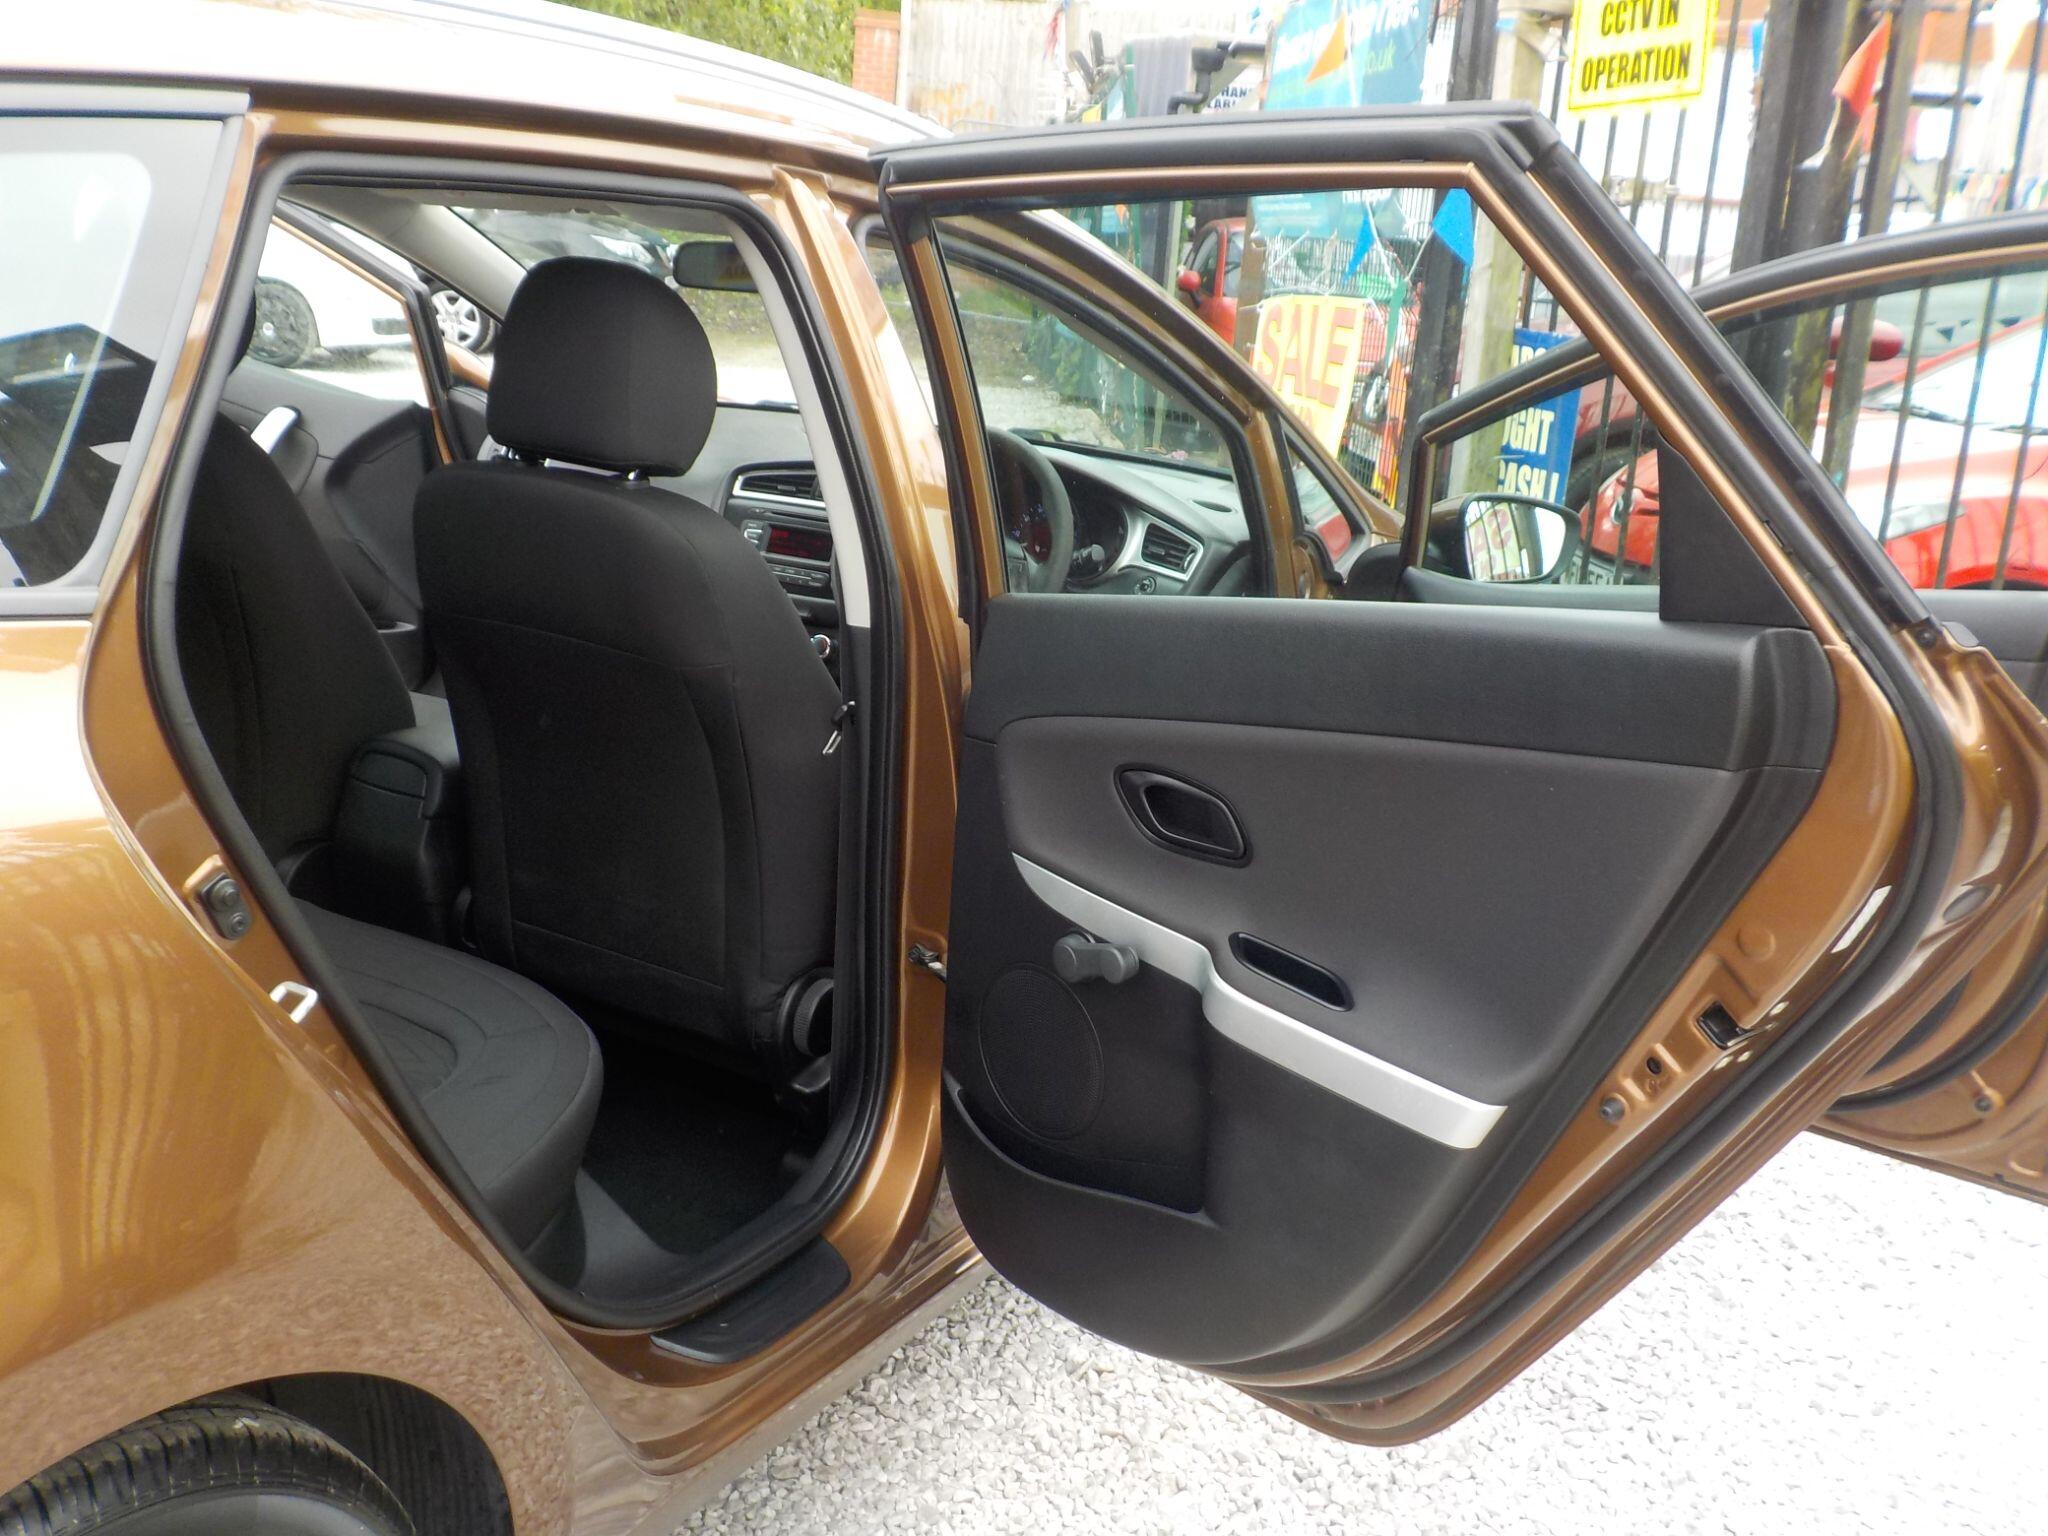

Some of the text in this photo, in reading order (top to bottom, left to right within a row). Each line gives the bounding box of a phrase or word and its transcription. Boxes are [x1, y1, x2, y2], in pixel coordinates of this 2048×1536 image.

[1601, 0, 1680, 36] CCTV IN
[1581, 42, 1691, 92] OPERATION
[1256, 303, 1357, 408] SALE
